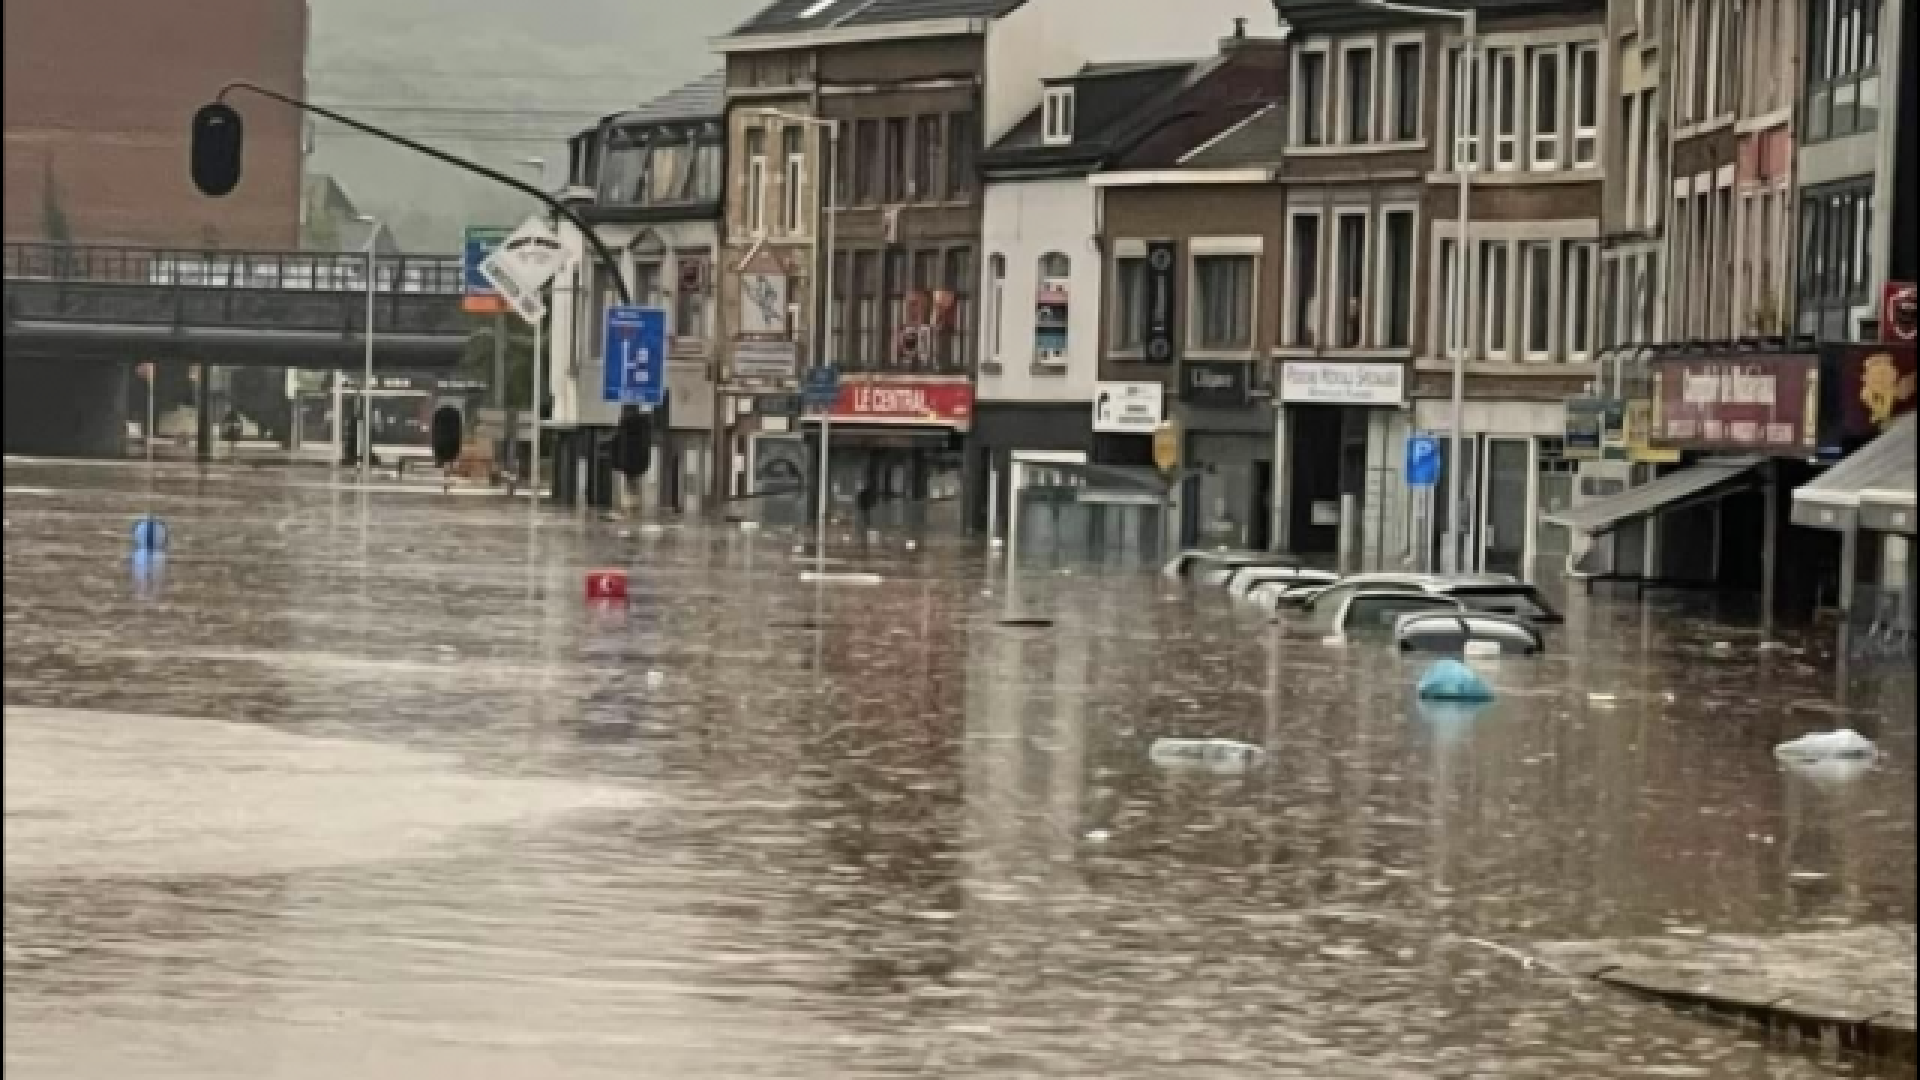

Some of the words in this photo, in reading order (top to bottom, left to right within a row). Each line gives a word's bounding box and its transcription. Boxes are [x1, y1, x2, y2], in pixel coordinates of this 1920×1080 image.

[854, 386, 871, 412] LE
[873, 387, 928, 413] CENTRAL
[1413, 441, 1432, 465] P
